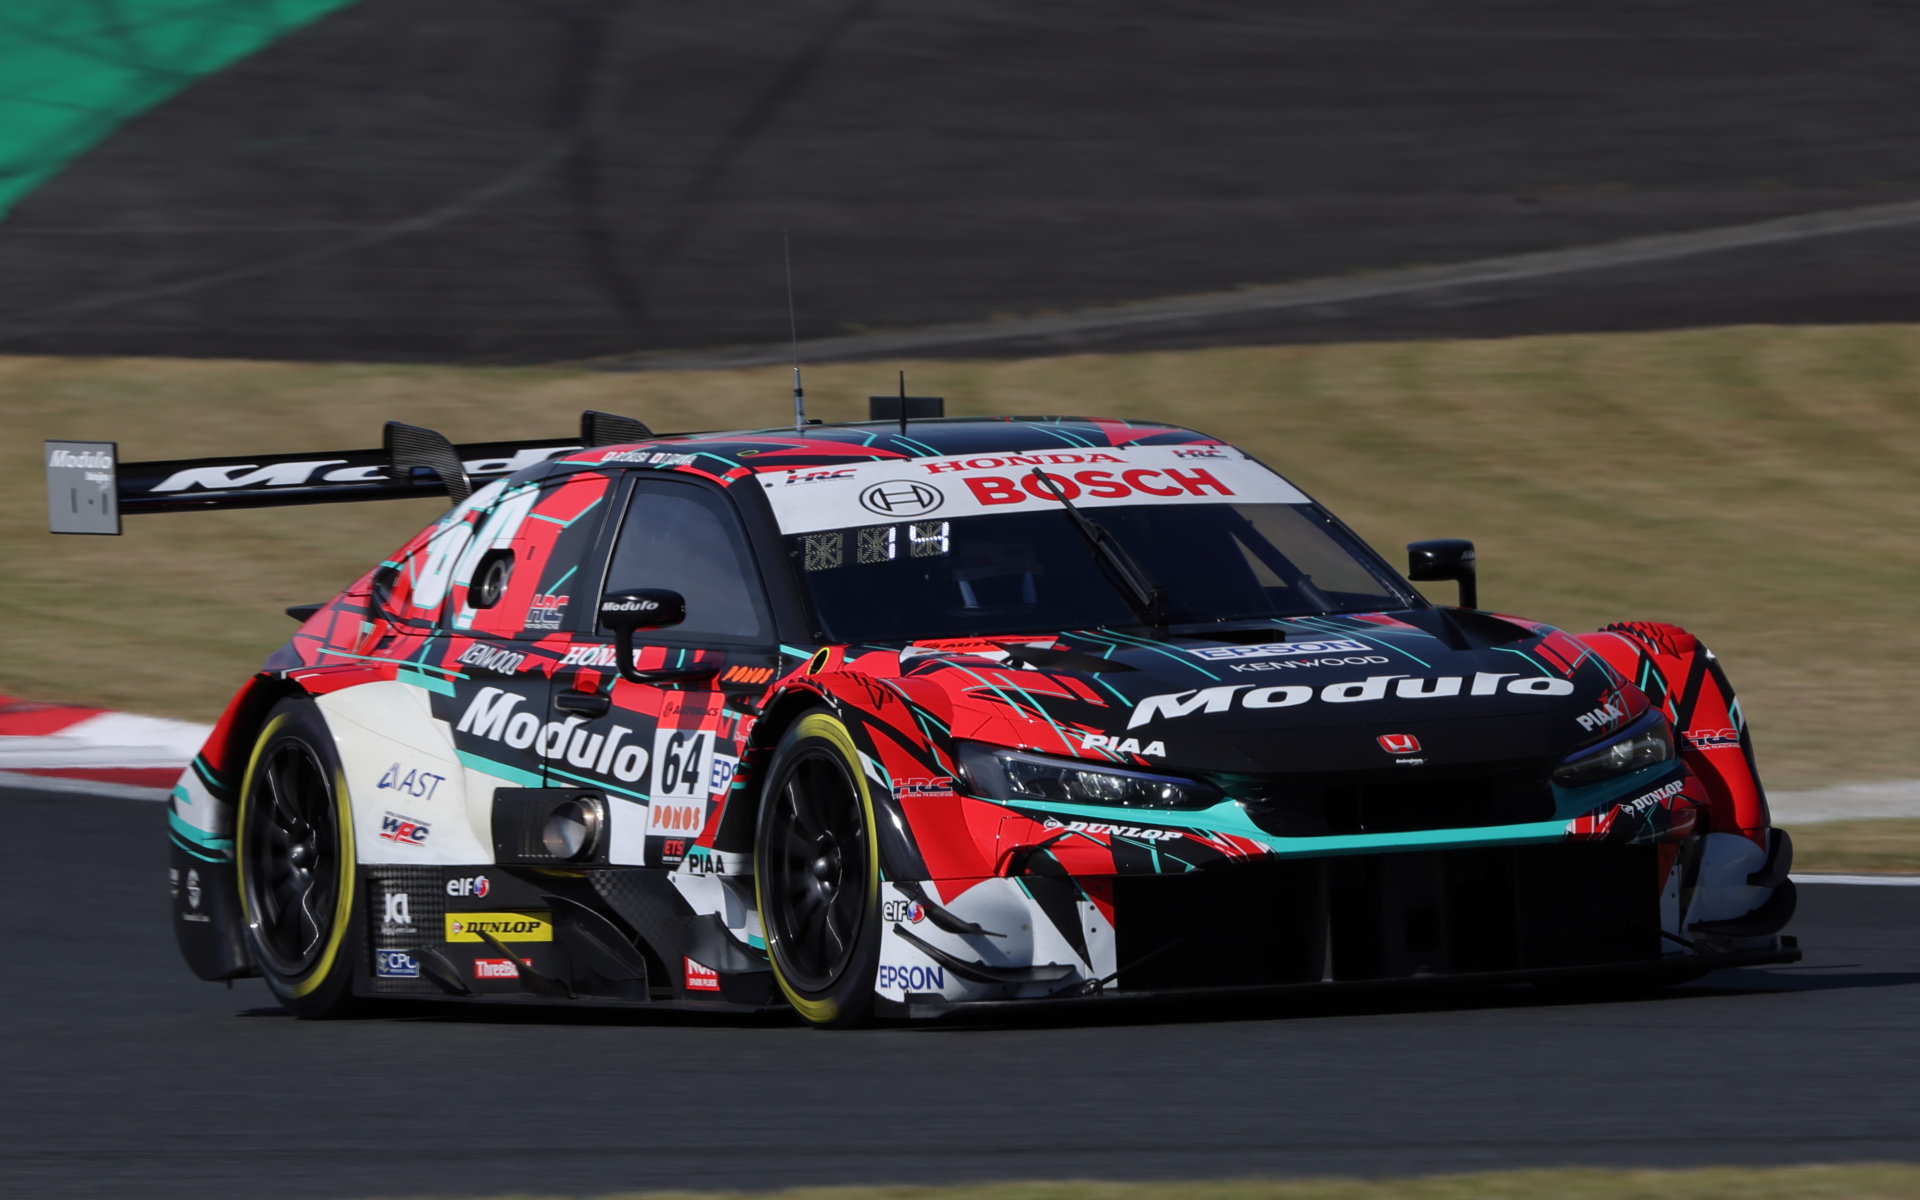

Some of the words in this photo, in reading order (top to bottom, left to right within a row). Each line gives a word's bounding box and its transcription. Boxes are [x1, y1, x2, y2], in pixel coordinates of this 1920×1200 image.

[920, 454, 1129, 474] HONDA
[786, 468, 857, 484] HRC
[963, 468, 1236, 506] BOSCH
[526, 594, 570, 623] HRC
[602, 600, 659, 611] Modulo
[457, 642, 525, 676] KENWOOD
[1200, 639, 1361, 658] EPSON
[721, 665, 775, 684] PONOS
[1230, 655, 1389, 673] KENWOOD
[1127, 672, 1575, 730] Modulo
[1576, 703, 1624, 732] PIAA
[456, 686, 649, 783] Modulo
[1681, 728, 1740, 748] HRC
[1081, 734, 1166, 757] PIAA
[662, 731, 706, 795] 64
[892, 777, 953, 796] HRC
[1631, 780, 1684, 810] DUNLOP
[382, 815, 430, 842] WPC
[652, 805, 701, 831] PONOS
[1064, 821, 1183, 841] DUNLOP
[664, 839, 685, 855] ETS
[689, 853, 725, 874] PIAA
[446, 877, 474, 897] elf
[883, 901, 908, 922] elf
[465, 921, 541, 934] DUNLOP
[880, 965, 944, 990] EPSON
